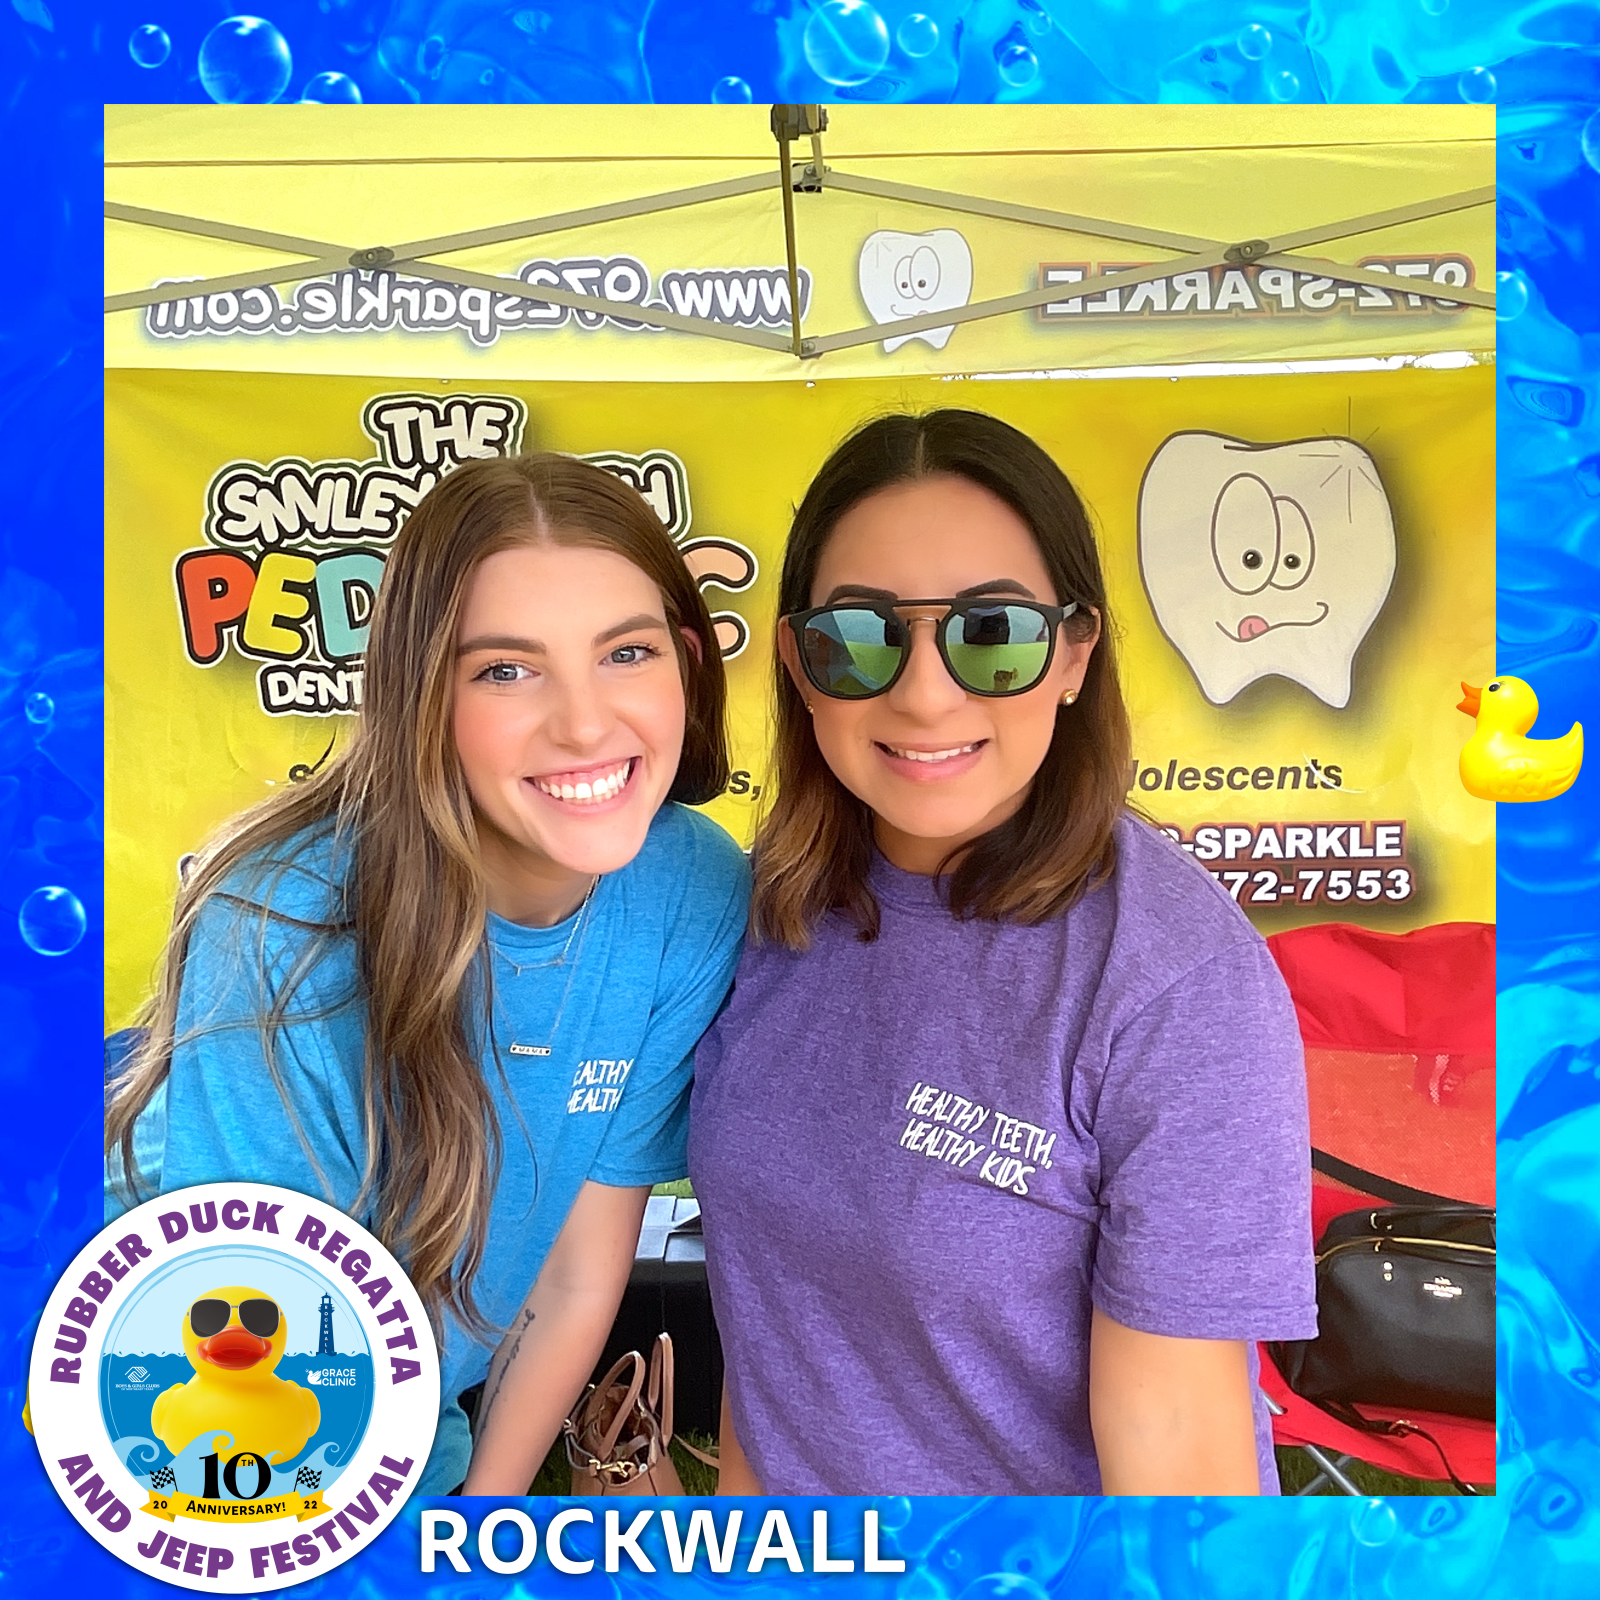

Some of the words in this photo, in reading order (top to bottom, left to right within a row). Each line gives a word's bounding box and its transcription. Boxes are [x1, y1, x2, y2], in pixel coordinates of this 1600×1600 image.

[380, 404, 509, 465] THE
[1130, 759, 1343, 791] olescents
[1159, 826, 1401, 860] -SPARKLE
[1208, 869, 1410, 902] 72-7553
[905, 1082, 990, 1134] HEALTHY
[991, 1111, 1057, 1170] TEETH,
[900, 1117, 986, 1168] HEALTHY
[979, 1150, 1036, 1195] KIDS
